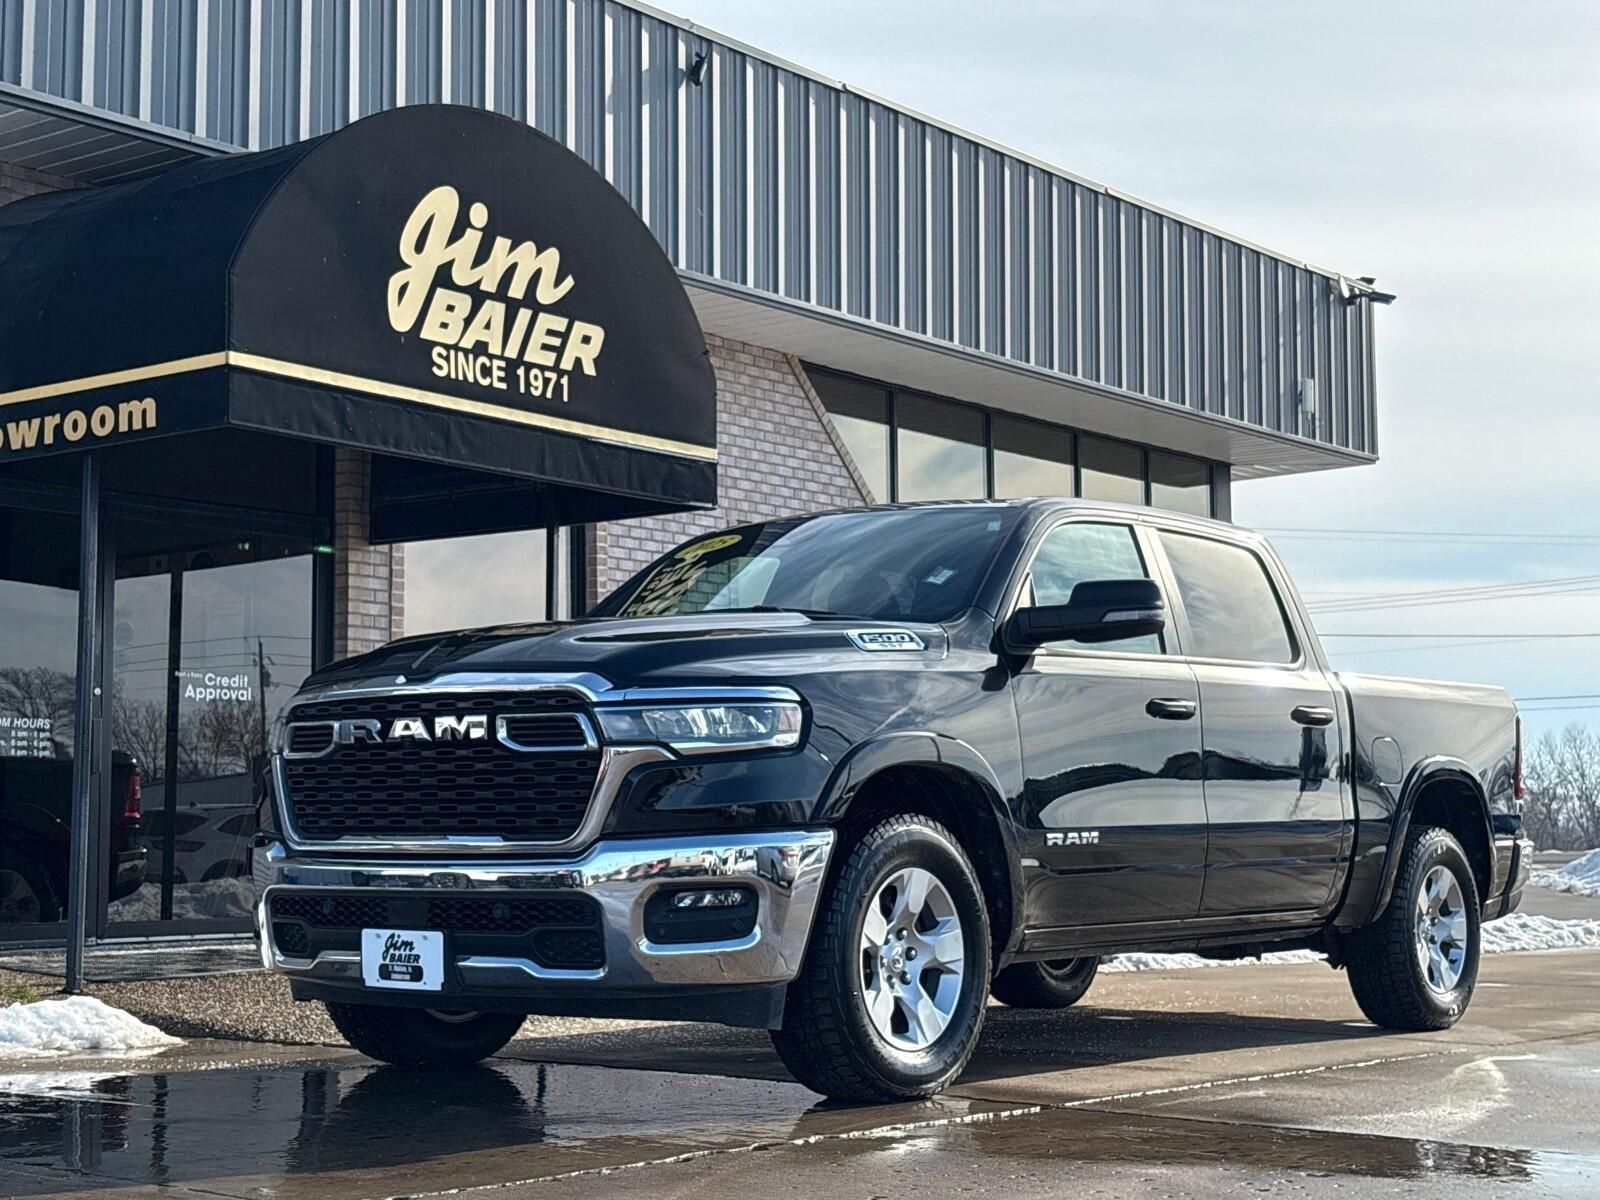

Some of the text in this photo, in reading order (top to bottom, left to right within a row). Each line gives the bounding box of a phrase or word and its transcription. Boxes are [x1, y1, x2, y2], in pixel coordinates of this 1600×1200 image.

[387, 186, 575, 333] Jim
[419, 287, 605, 377] BAIER
[431, 346, 569, 402] SINCE 1971
[0, 397, 157, 451] wroom
[862, 633, 911, 643] 1500
[184, 683, 252, 702] Approval
[204, 673, 248, 688] Credit
[0, 717, 51, 729] M HOURS
[335, 714, 488, 744] RAM
[1045, 831, 1099, 847] RAM
[382, 932, 416, 962] Jim
[389, 953, 421, 964] BAIER
